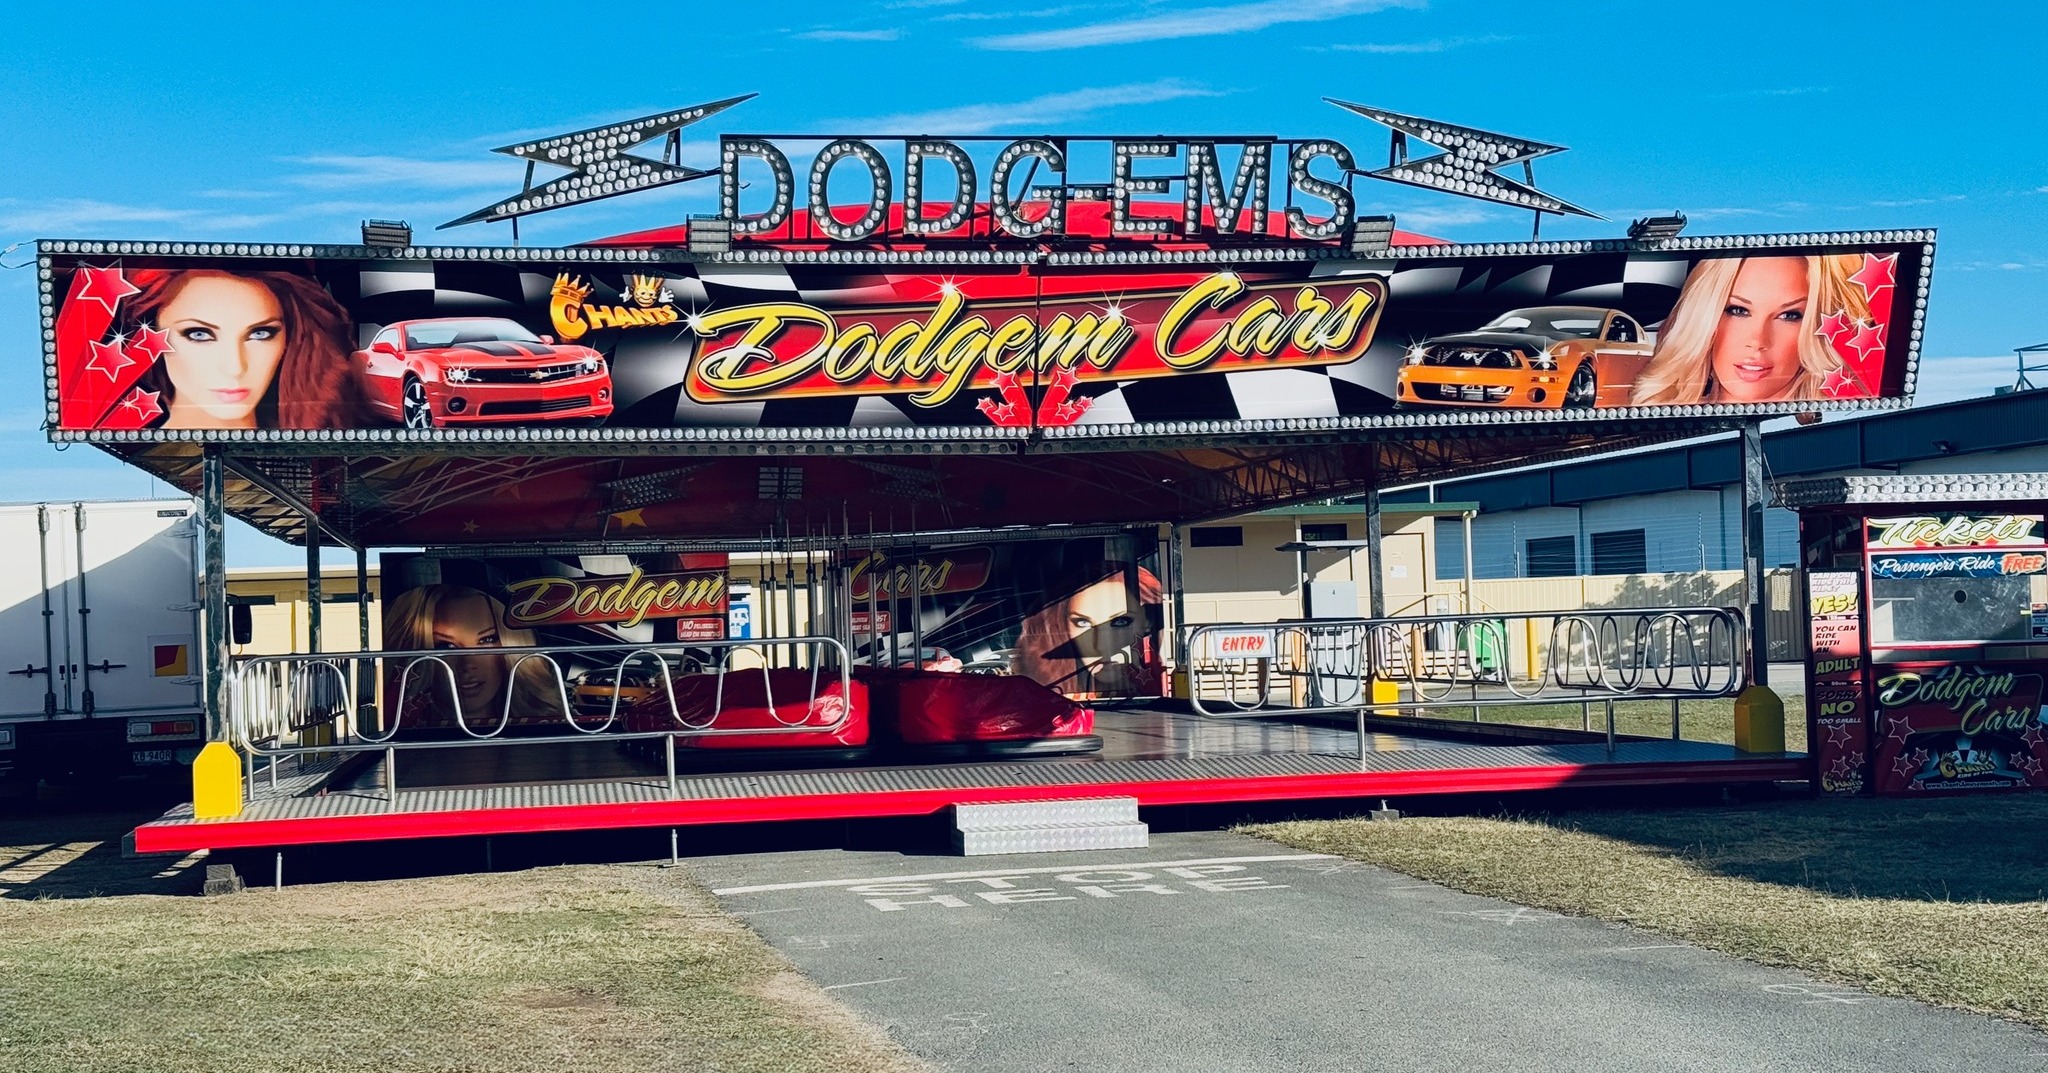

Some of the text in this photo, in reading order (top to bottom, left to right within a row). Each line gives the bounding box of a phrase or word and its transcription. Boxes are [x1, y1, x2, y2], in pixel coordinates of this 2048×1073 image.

[550, 293, 679, 340] CHANTS
[692, 271, 1378, 407] Dodgem Cars
[1867, 513, 2036, 546] Tickets
[850, 550, 955, 601] Cars
[1878, 553, 2044, 577] Passengers Ride FREE
[508, 566, 726, 628] Dodgem
[1811, 592, 1859, 616] YES!
[1221, 636, 1265, 651] ENTRY
[1814, 647, 1830, 655] AN
[1815, 657, 1860, 674] ADULT
[1878, 665, 2015, 710] Dodgem
[1820, 700, 1856, 716] NO
[1961, 698, 2032, 736] Cars
[847, 864, 1247, 898] STOP
[864, 876, 1291, 912] HERE
